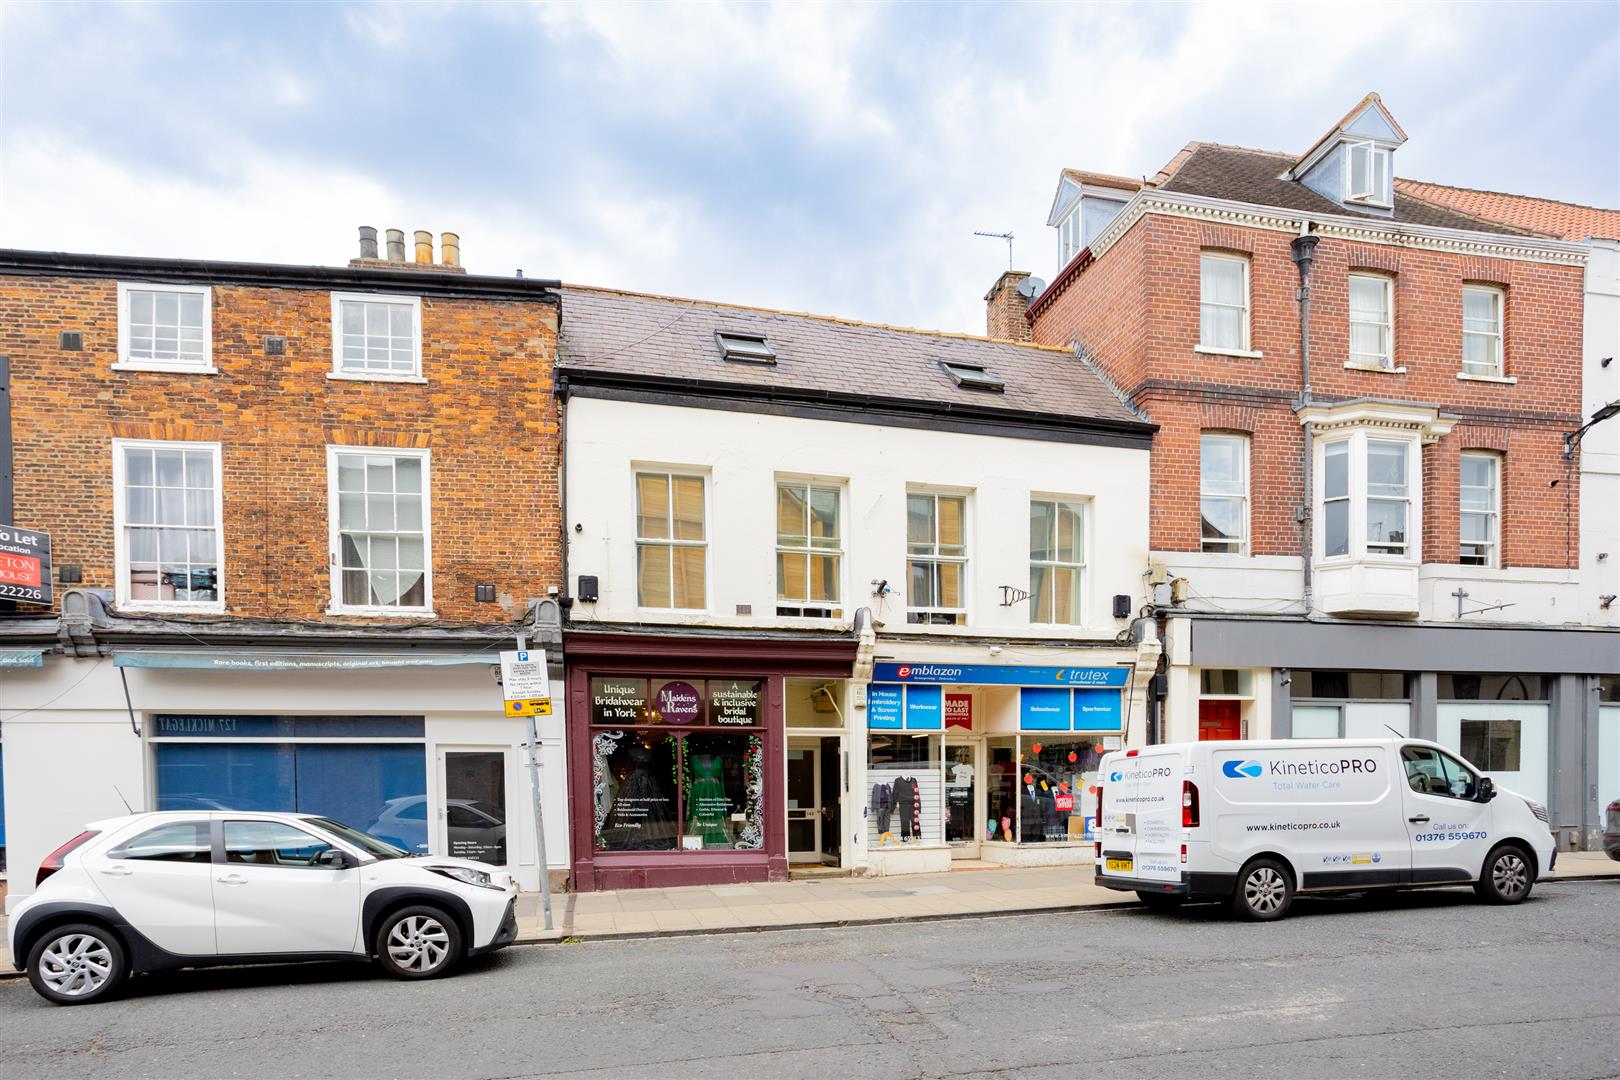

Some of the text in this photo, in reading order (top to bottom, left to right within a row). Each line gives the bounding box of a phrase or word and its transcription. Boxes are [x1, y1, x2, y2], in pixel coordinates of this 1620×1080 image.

[14, 532, 38, 546] Let
[520, 652, 527, 660] P
[899, 664, 962, 677] emblazon
[1069, 669, 1110, 681] trutex
[603, 684, 636, 696] Unique
[731, 682, 739, 690] A
[661, 690, 697, 703] Maidens
[712, 690, 758, 699] sustainable
[594, 696, 645, 707] Bridalwear
[713, 698, 757, 708] & inclusive
[945, 700, 969, 708] MADE
[603, 707, 637, 718] in York
[667, 701, 698, 714] Ravens
[723, 706, 747, 716] bridal
[717, 715, 753, 726] boutique
[1270, 758, 1377, 775] KineticoPRO
[1125, 767, 1171, 779] KineticoPRO
[1273, 780, 1341, 791] Total Water Care
[1246, 820, 1341, 832] www.kineticopro.co.uk
[1432, 823, 1446, 831] Call
[1415, 831, 1488, 842] 01376 559670
